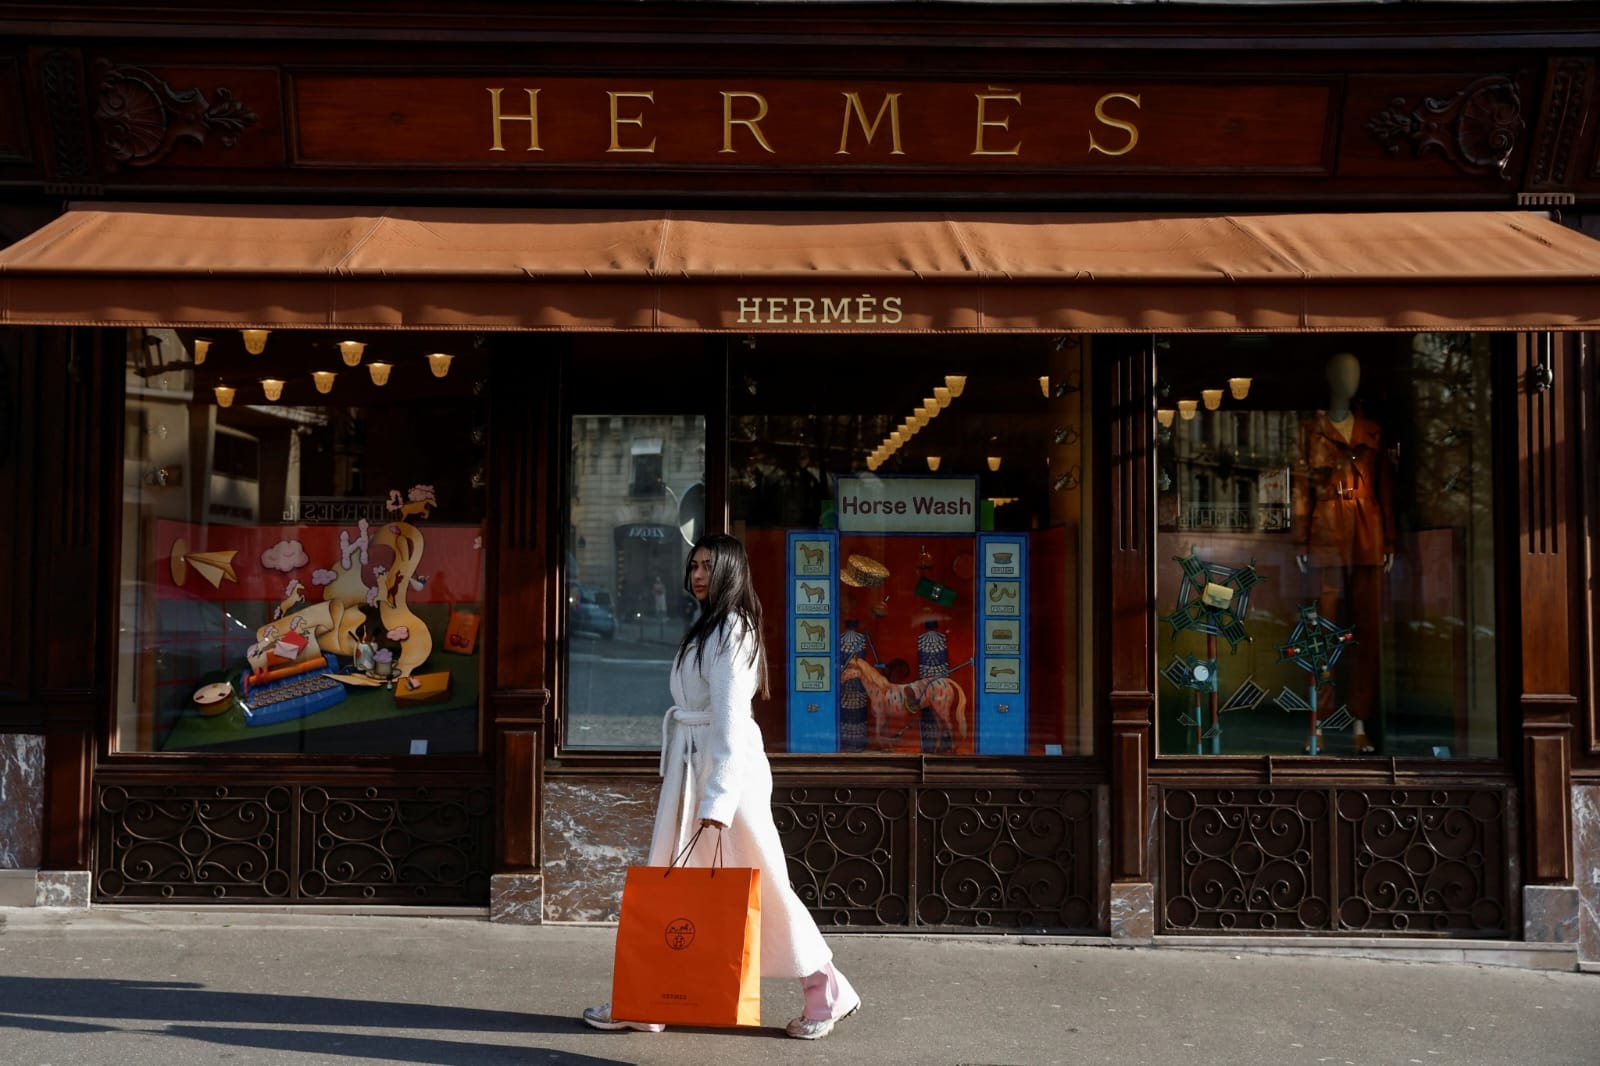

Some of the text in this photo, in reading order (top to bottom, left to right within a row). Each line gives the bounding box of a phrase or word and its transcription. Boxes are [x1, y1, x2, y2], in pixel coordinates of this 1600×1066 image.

[485, 84, 1141, 158] HERMÈS
[736, 293, 903, 325] HERMÈS
[842, 496, 972, 515] Horse Wash
